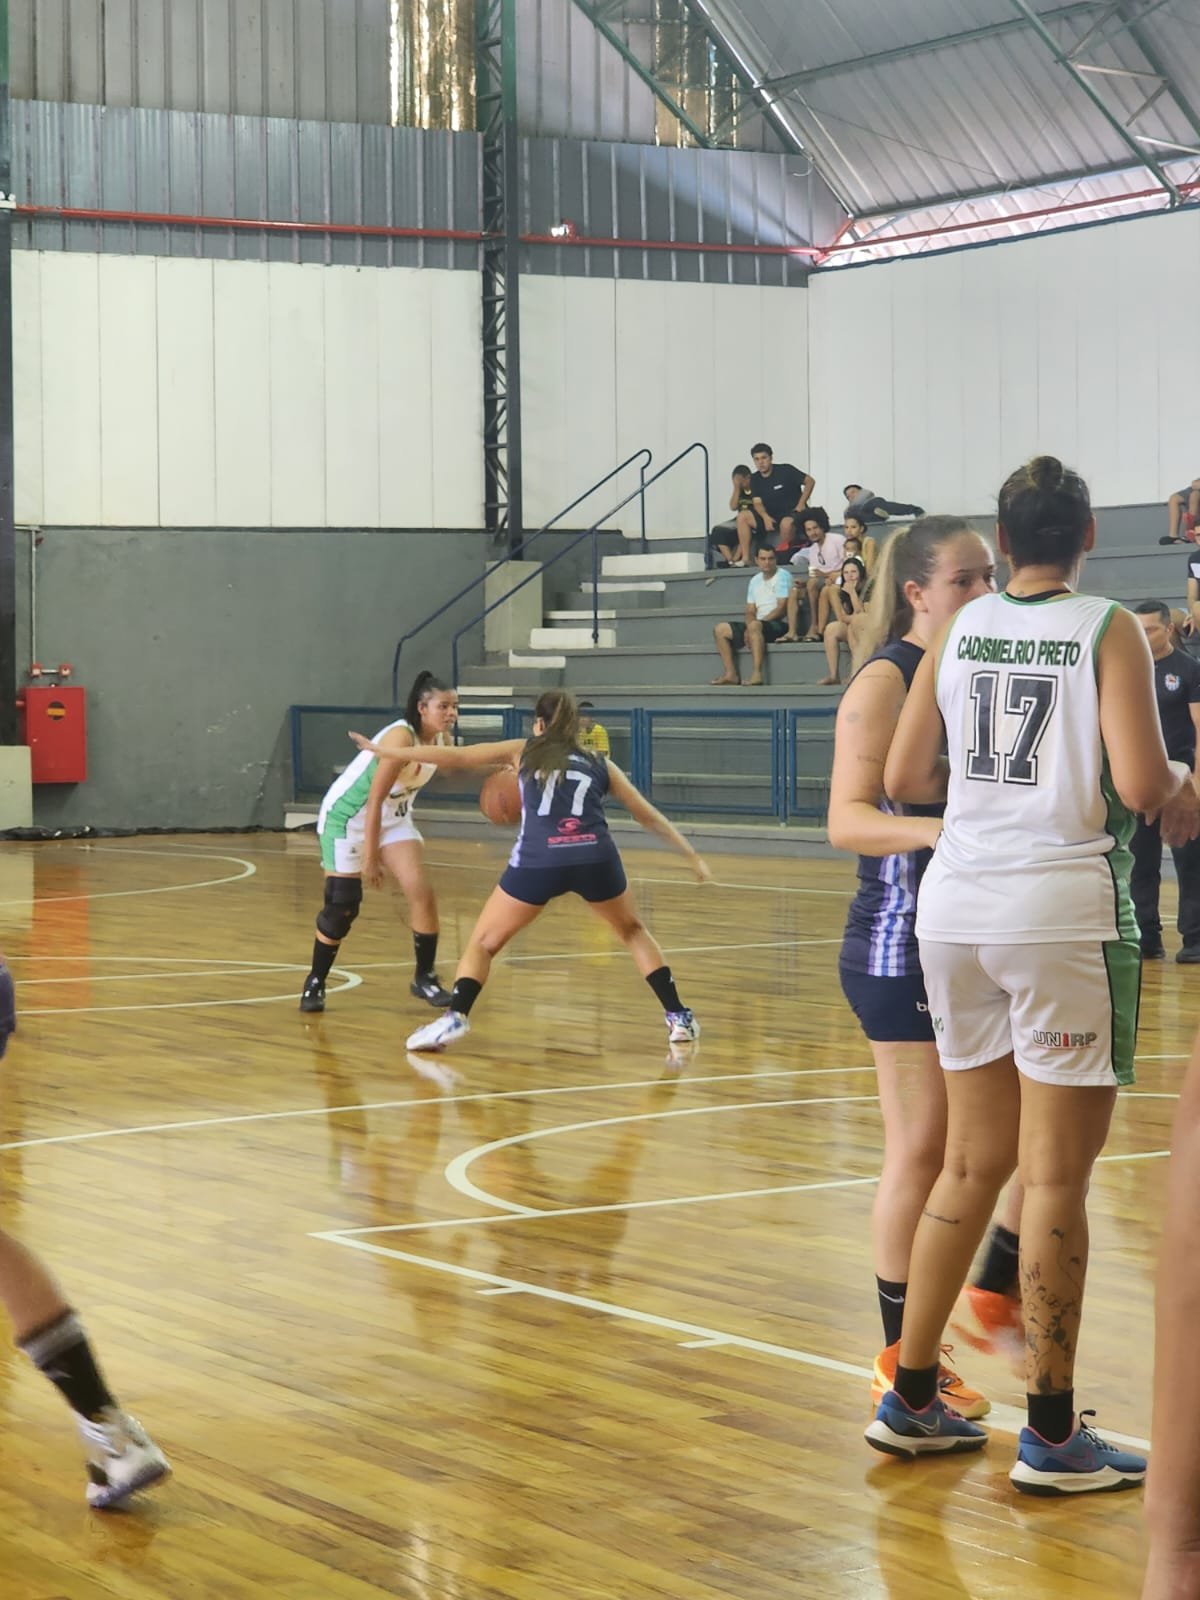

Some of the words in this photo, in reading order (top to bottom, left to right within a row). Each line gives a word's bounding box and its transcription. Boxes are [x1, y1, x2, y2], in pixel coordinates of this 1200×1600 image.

[1036, 640, 1081, 666] PRETO
[966, 670, 1058, 785] 17
[534, 769, 592, 817] 77
[1032, 1029, 1098, 1048] UNIRP
